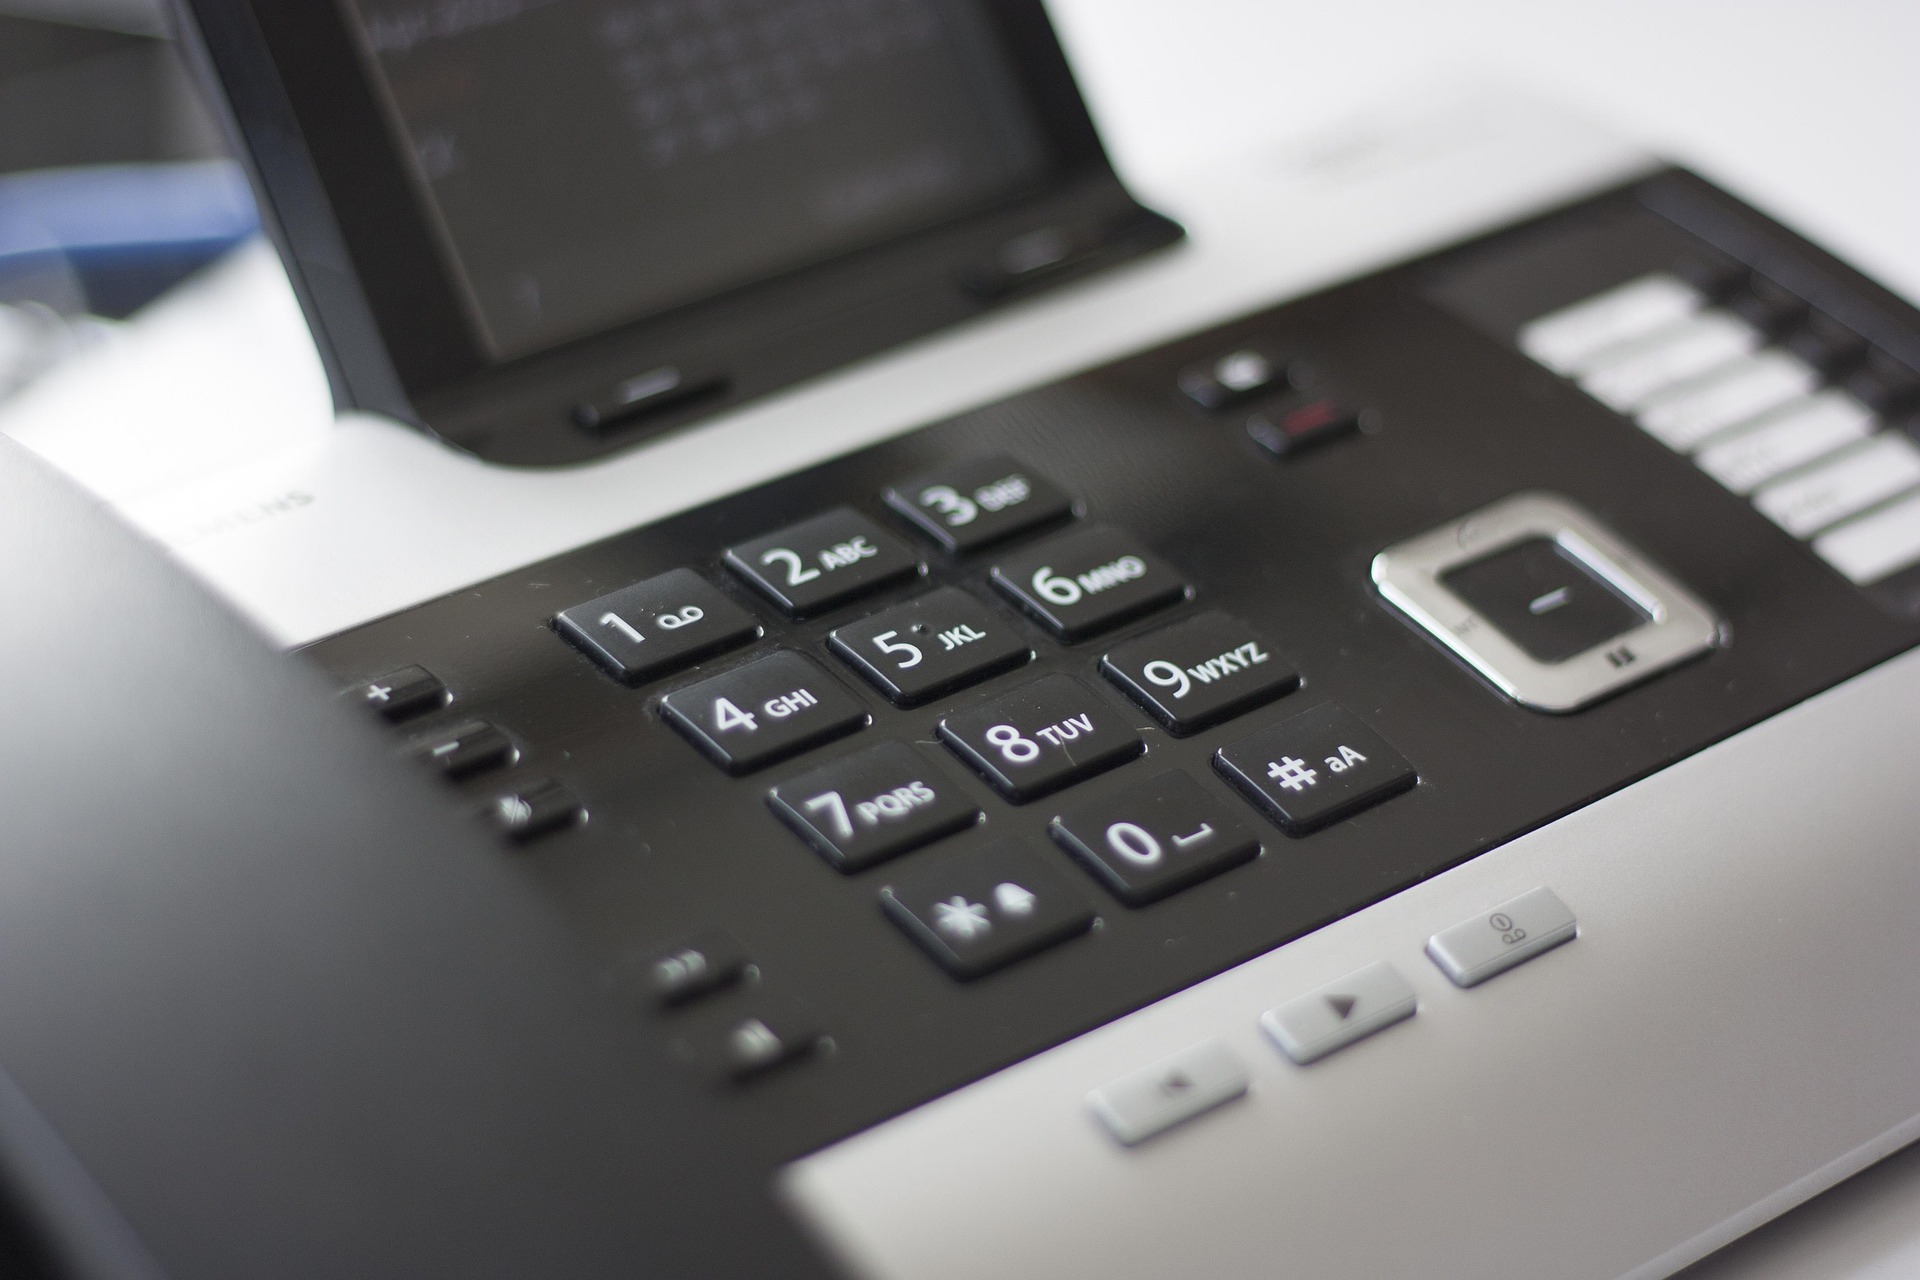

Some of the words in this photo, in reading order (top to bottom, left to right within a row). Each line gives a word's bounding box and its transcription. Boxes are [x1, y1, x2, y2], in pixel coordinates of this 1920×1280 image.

[919, 486, 978, 527] 3
[761, 548, 822, 587] 2
[817, 534, 879, 572] ABC
[1031, 565, 1082, 606] 6
[1077, 554, 1148, 595] MNO
[599, 611, 647, 644] 1
[871, 629, 924, 669] 5
[936, 623, 988, 652] JKL
[1142, 659, 1192, 699] 9
[1187, 640, 1270, 684] WXYZ
[713, 696, 759, 732] 4
[763, 687, 819, 719] GHI
[984, 724, 1041, 763] 8
[1035, 712, 1095, 747] TUV
[1266, 755, 1318, 792] #
[1324, 744, 1368, 773] aA
[804, 790, 855, 839] 7
[853, 780, 937, 825] PQRS
[1106, 821, 1163, 865] 0
